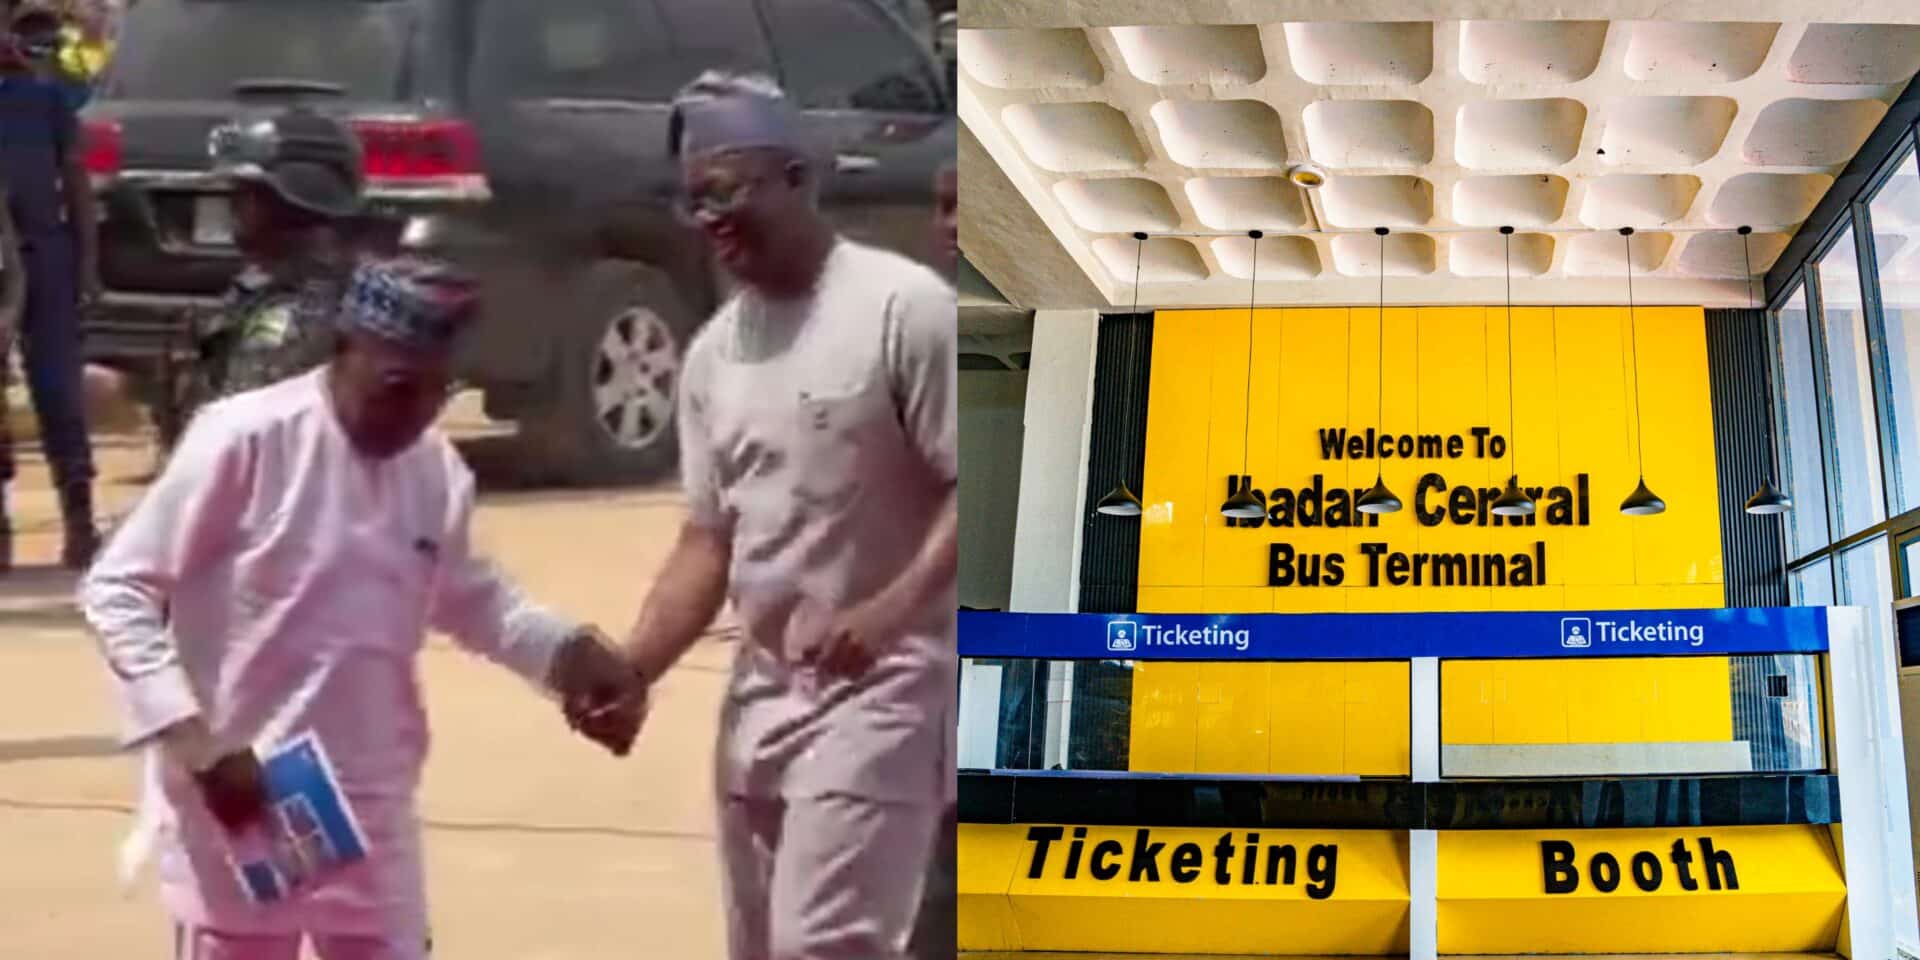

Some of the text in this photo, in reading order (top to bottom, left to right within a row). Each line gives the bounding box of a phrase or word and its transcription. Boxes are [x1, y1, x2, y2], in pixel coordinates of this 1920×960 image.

[1319, 426, 1506, 460] Welcome To
[1268, 541, 1546, 586] Bus Terminal
[1142, 624, 1250, 651] Ticketing
[1596, 620, 1704, 646] Ticketing
[1026, 826, 1338, 899] Ticketing
[1541, 837, 1739, 894] Booth
